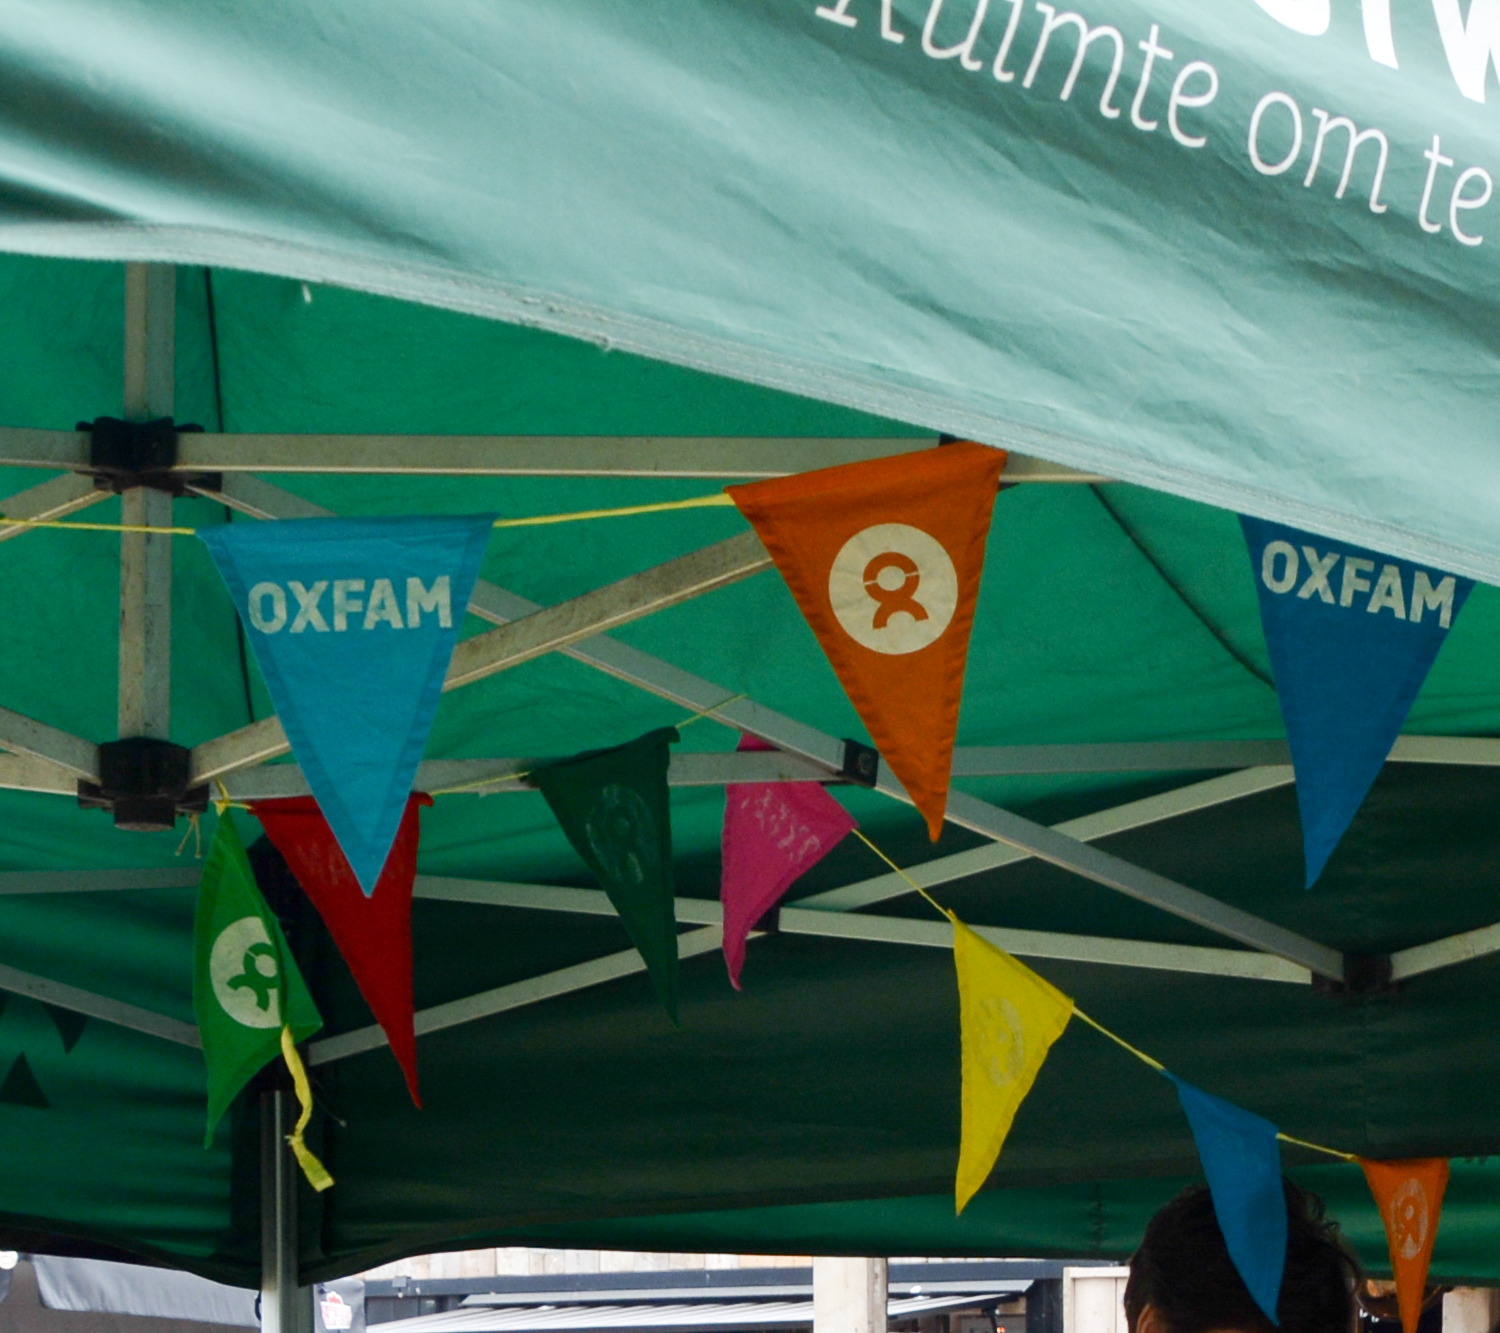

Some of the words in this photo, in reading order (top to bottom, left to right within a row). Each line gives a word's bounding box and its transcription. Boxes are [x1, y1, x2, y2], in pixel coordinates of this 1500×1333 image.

[1248, 91, 1388, 214] om
[1417, 133, 1493, 246] te
[248, 575, 453, 635] OXFAM
[1261, 539, 1457, 629] OXFAM
